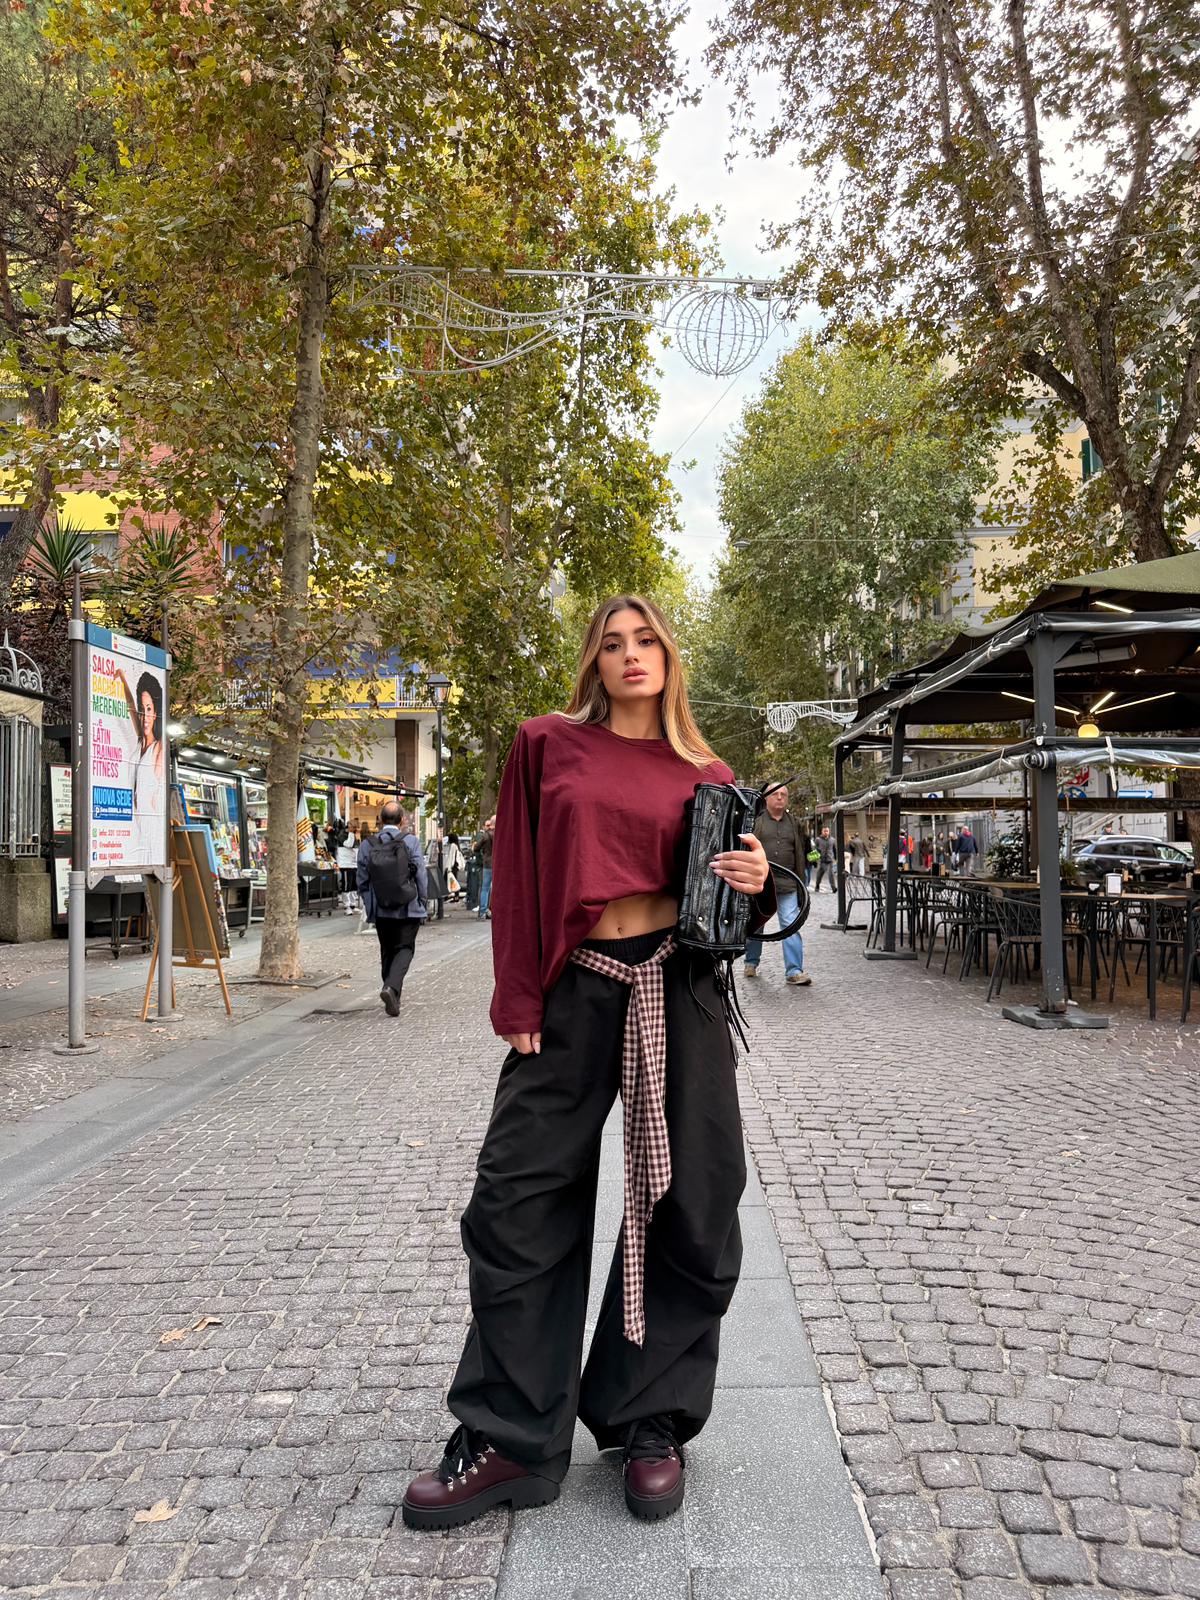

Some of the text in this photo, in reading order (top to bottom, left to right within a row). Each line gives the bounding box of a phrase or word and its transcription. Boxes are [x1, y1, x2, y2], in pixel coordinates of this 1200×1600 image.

[92, 654, 115, 677] SALSA
[92, 694, 130, 720] MERENGUE
[92, 726, 112, 746] LATIN
[92, 743, 123, 763] TRAINING
[92, 760, 119, 779] FITNESS
[93, 787, 132, 807] NUOVA SEDE
